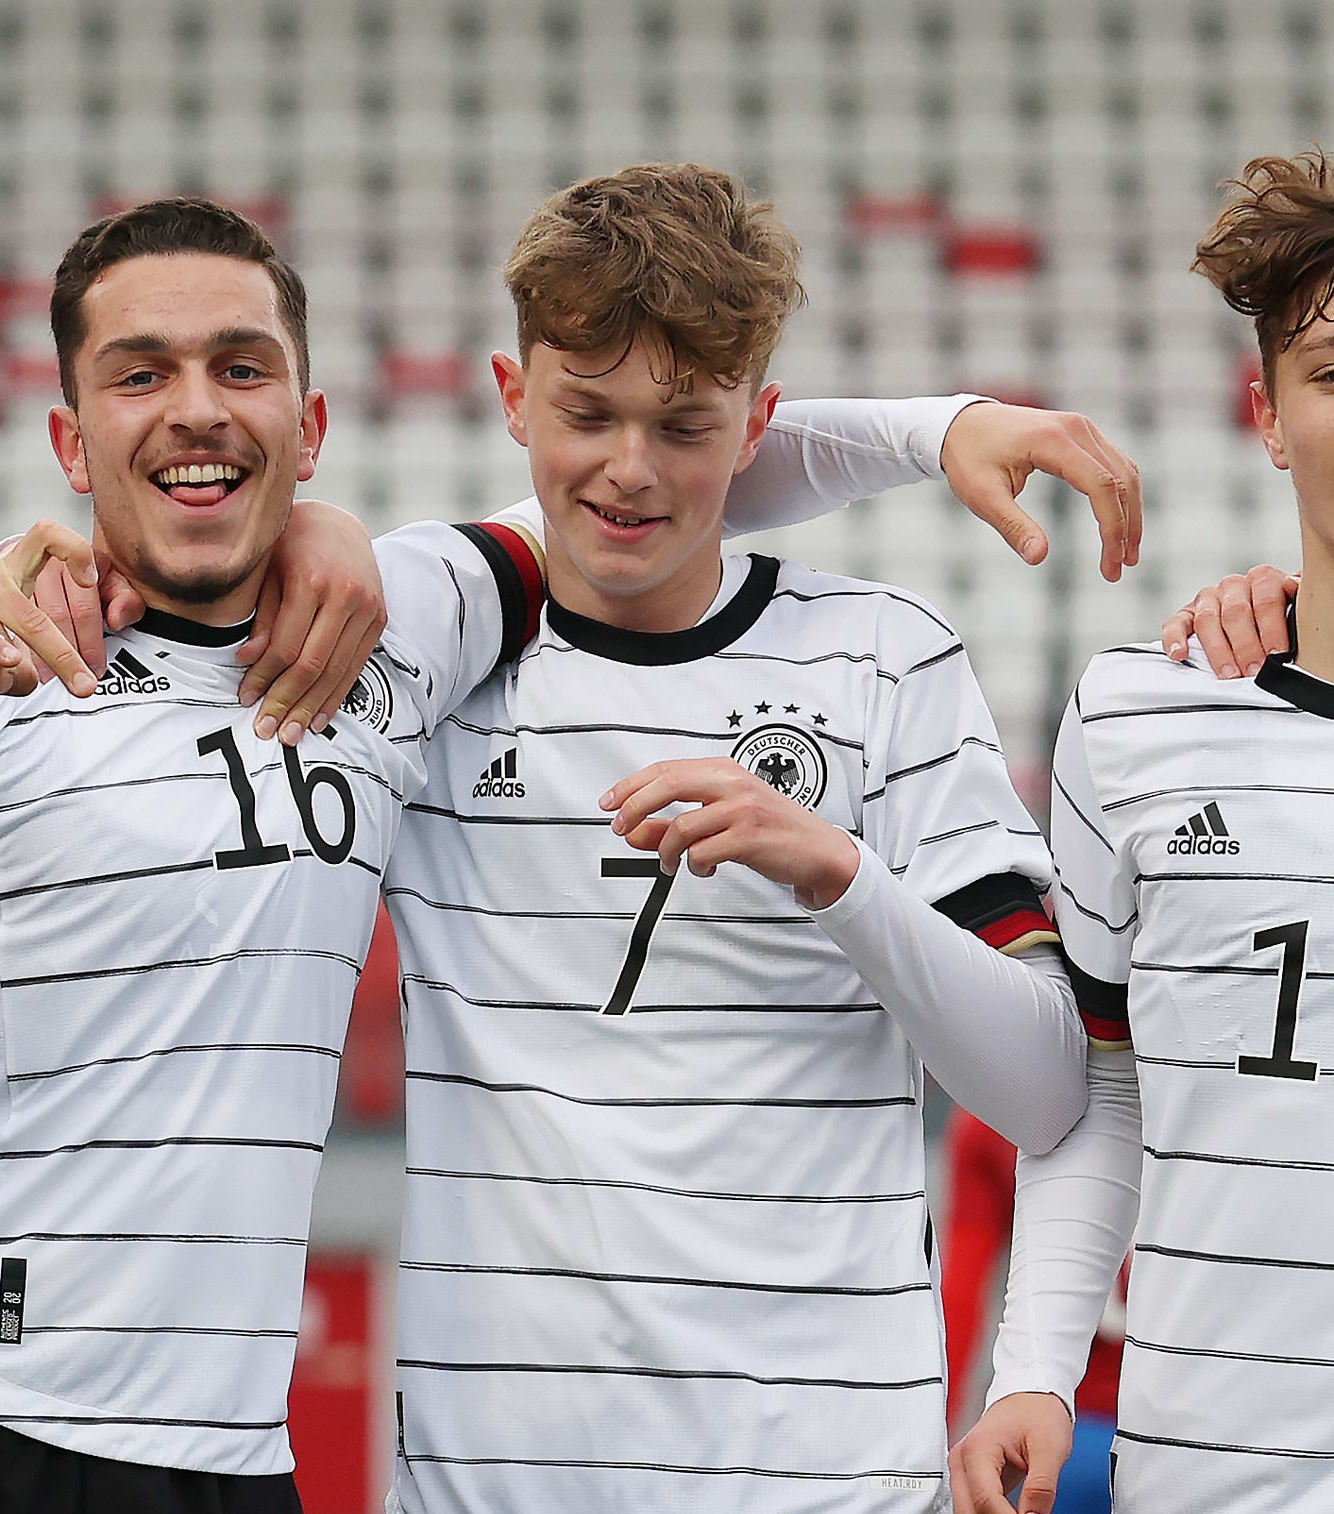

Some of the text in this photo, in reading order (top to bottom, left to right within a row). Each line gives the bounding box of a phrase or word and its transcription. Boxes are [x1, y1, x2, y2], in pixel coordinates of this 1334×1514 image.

[747, 736, 806, 757] DEUTSCHER
[197, 726, 356, 870] 16
[472, 777, 525, 799] adidas
[1167, 833, 1240, 857] adidas
[600, 857, 681, 1016] 7
